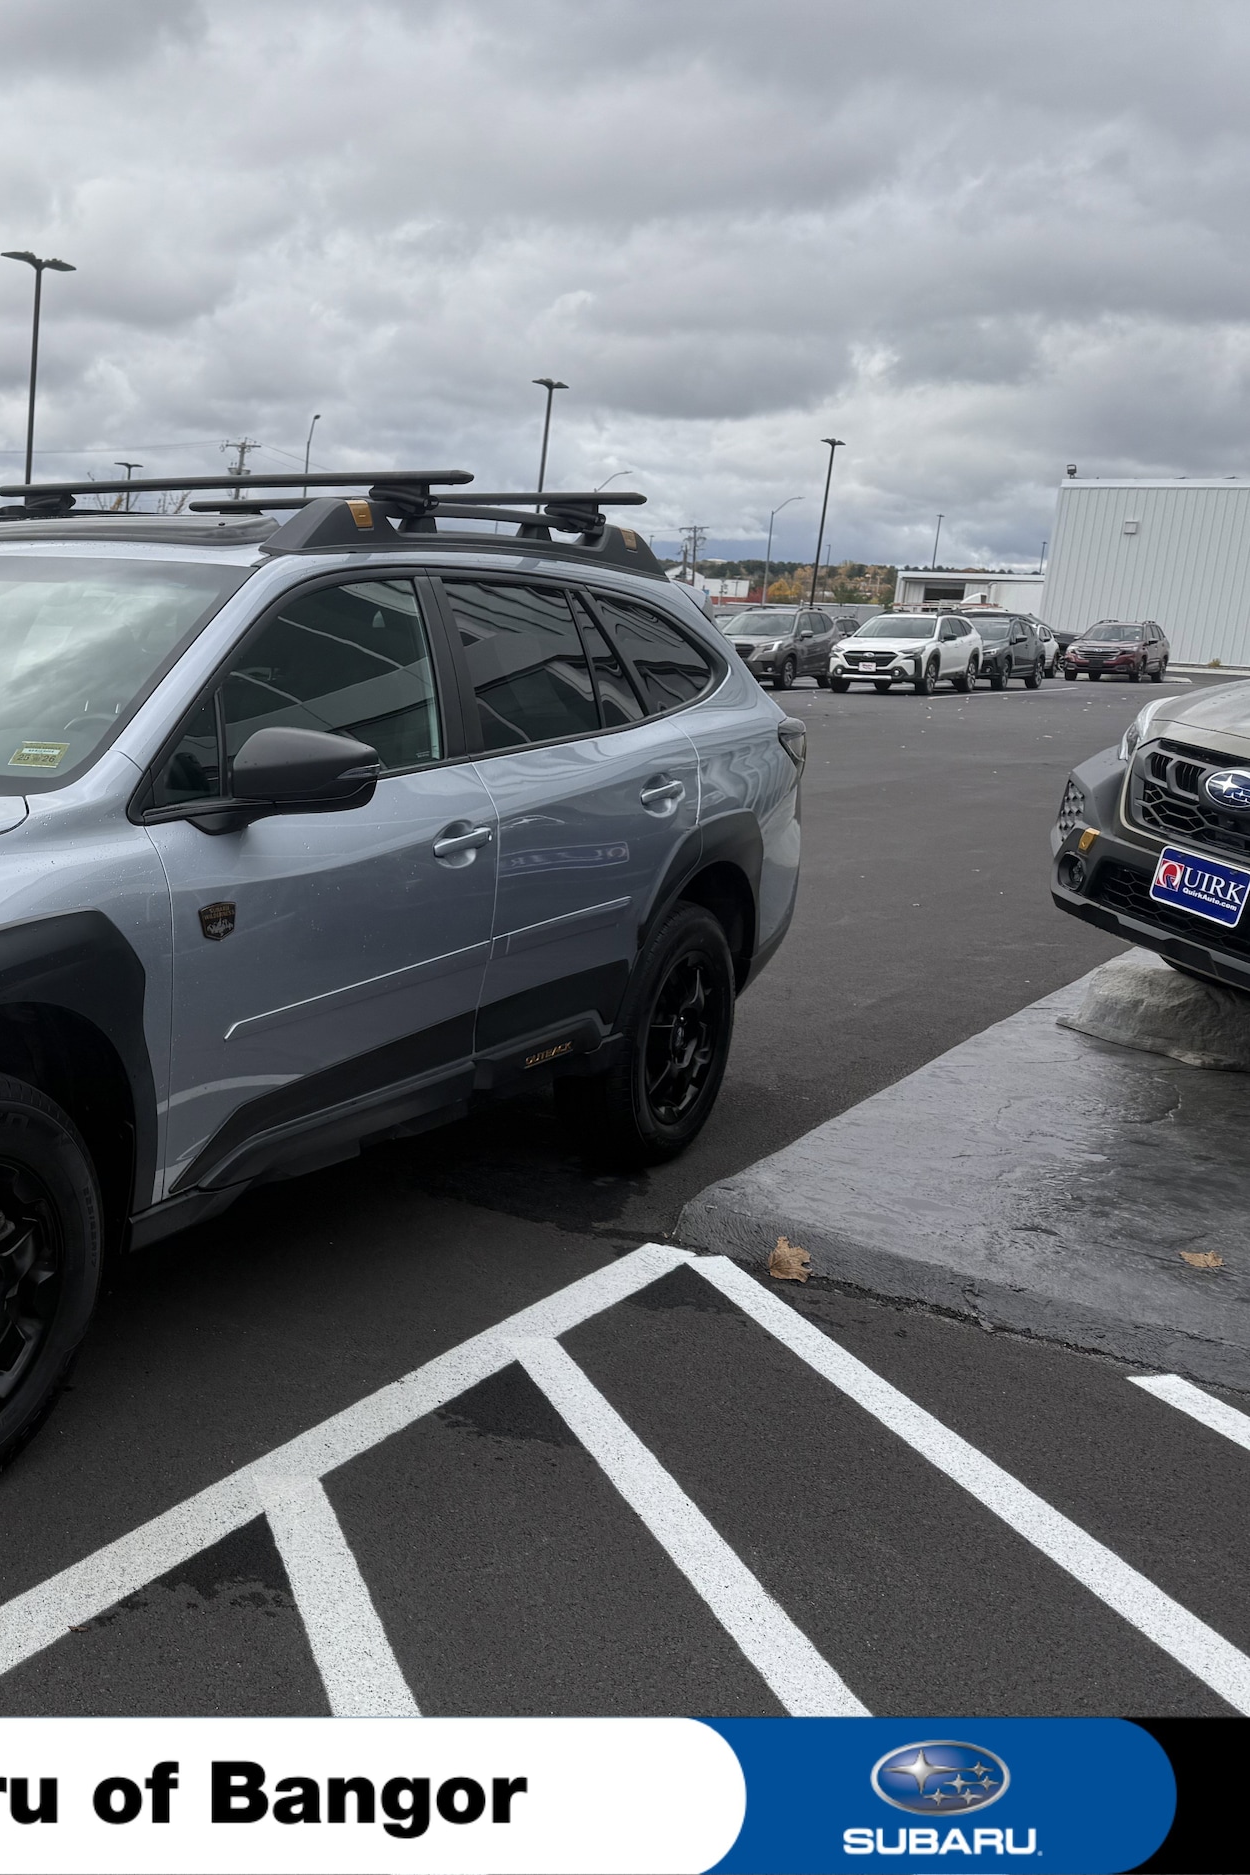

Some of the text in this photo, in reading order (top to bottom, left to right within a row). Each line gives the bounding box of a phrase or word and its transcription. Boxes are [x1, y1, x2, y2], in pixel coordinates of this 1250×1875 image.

[41, 754, 56, 763] 26
[1158, 861, 1246, 905] QUIRK
[1182, 887, 1238, 912] QuirkAuto.com
[525, 1041, 573, 1066] OUTBACK
